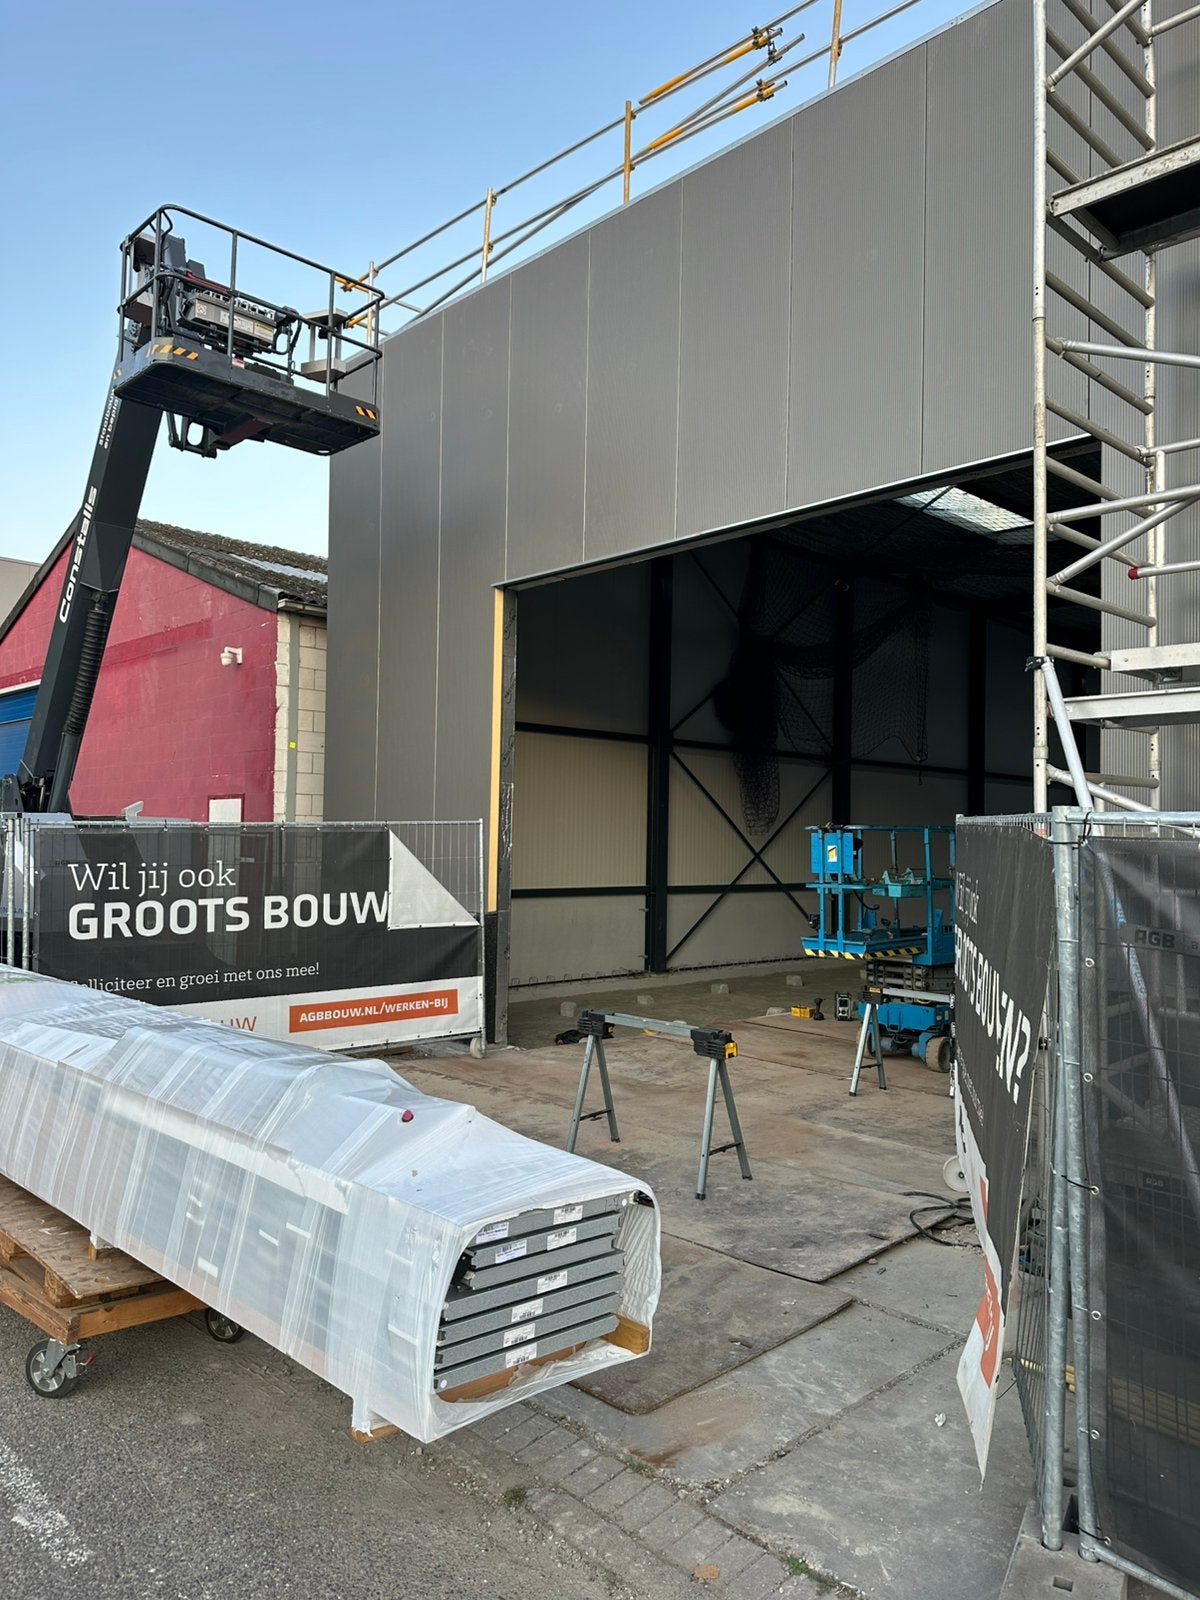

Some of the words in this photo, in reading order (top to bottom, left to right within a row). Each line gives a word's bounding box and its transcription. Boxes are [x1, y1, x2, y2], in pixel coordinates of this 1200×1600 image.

[107, 396, 120, 432] bepla
[59, 485, 98, 624] Constalls
[67, 862, 130, 891] Wil
[138, 862, 168, 897] jij
[178, 860, 236, 888] ook
[68, 896, 250, 941] GROOTS
[263, 890, 389, 930] BOUW
[1134, 928, 1176, 949] AGB
[156, 976, 176, 989] en
[179, 969, 220, 990] groei
[223, 968, 252, 983] met
[256, 969, 283, 980] ons
[285, 961, 320, 978] mee!
[299, 997, 449, 1023] AGBBOUW.NL/WERKEN-BIJ
